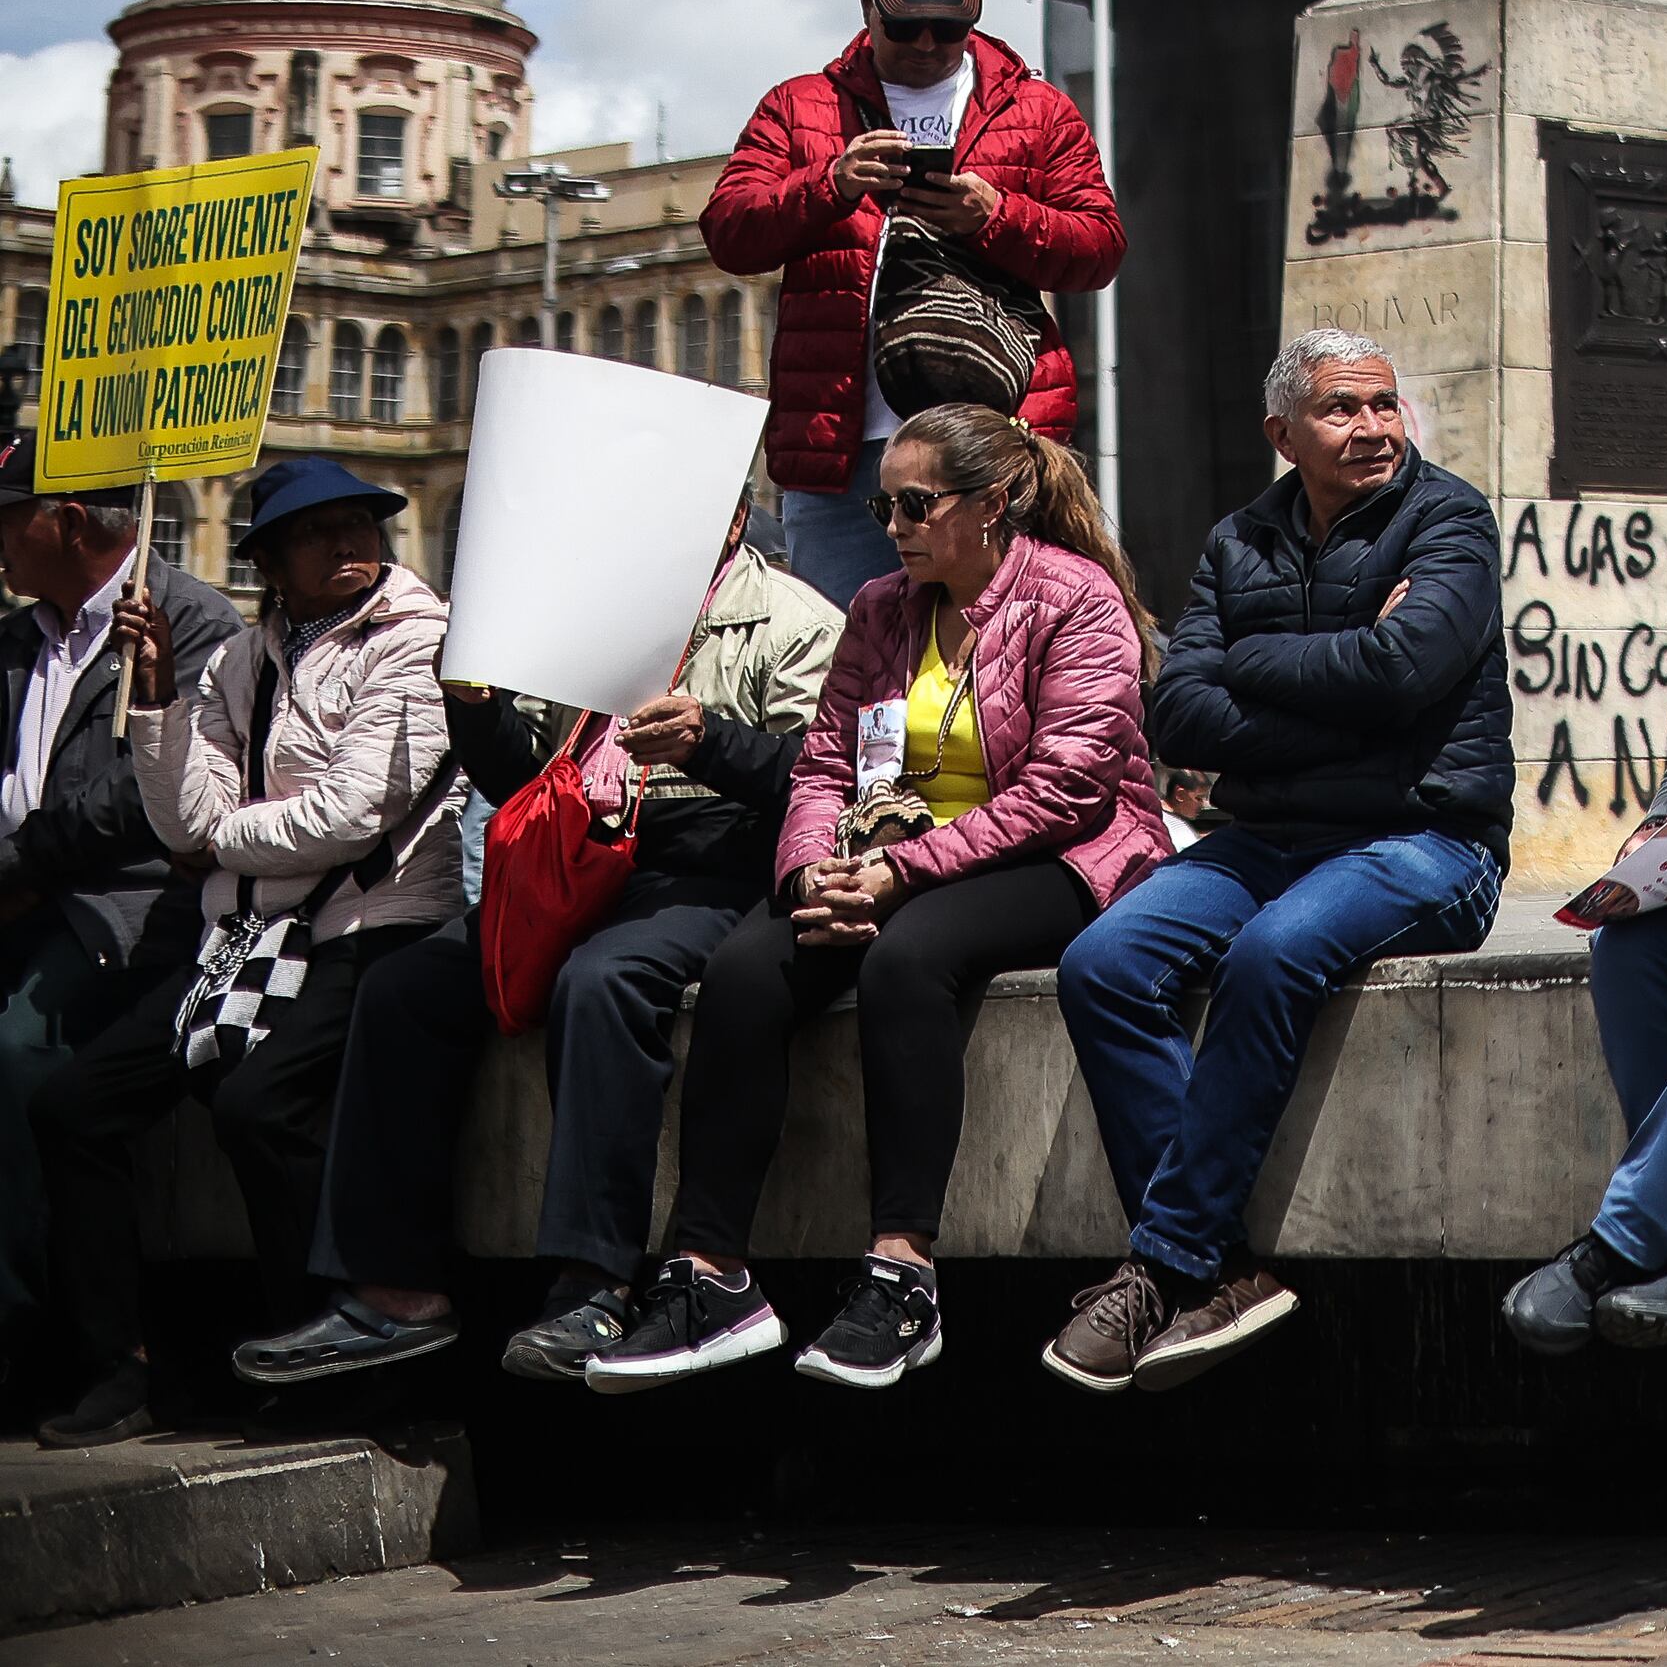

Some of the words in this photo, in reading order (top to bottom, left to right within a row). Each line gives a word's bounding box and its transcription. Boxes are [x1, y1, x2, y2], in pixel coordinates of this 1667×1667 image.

[74, 214, 125, 279] SOY
[128, 190, 298, 272] SOBREVIVIENTE
[61, 296, 99, 360] DEL
[106, 282, 202, 356] GENOCIDIO
[206, 271, 283, 343] CONTRA
[1312, 292, 1459, 332] BOLIVAR
[54, 377, 84, 442] LA
[90, 359, 149, 437] UNIÓN
[149, 348, 267, 430] PATRIÓTICA
[138, 436, 209, 461] Corporación
[210, 431, 252, 451] Reiniciar
[1503, 501, 1548, 581] A
[1512, 600, 1606, 701] SIN
